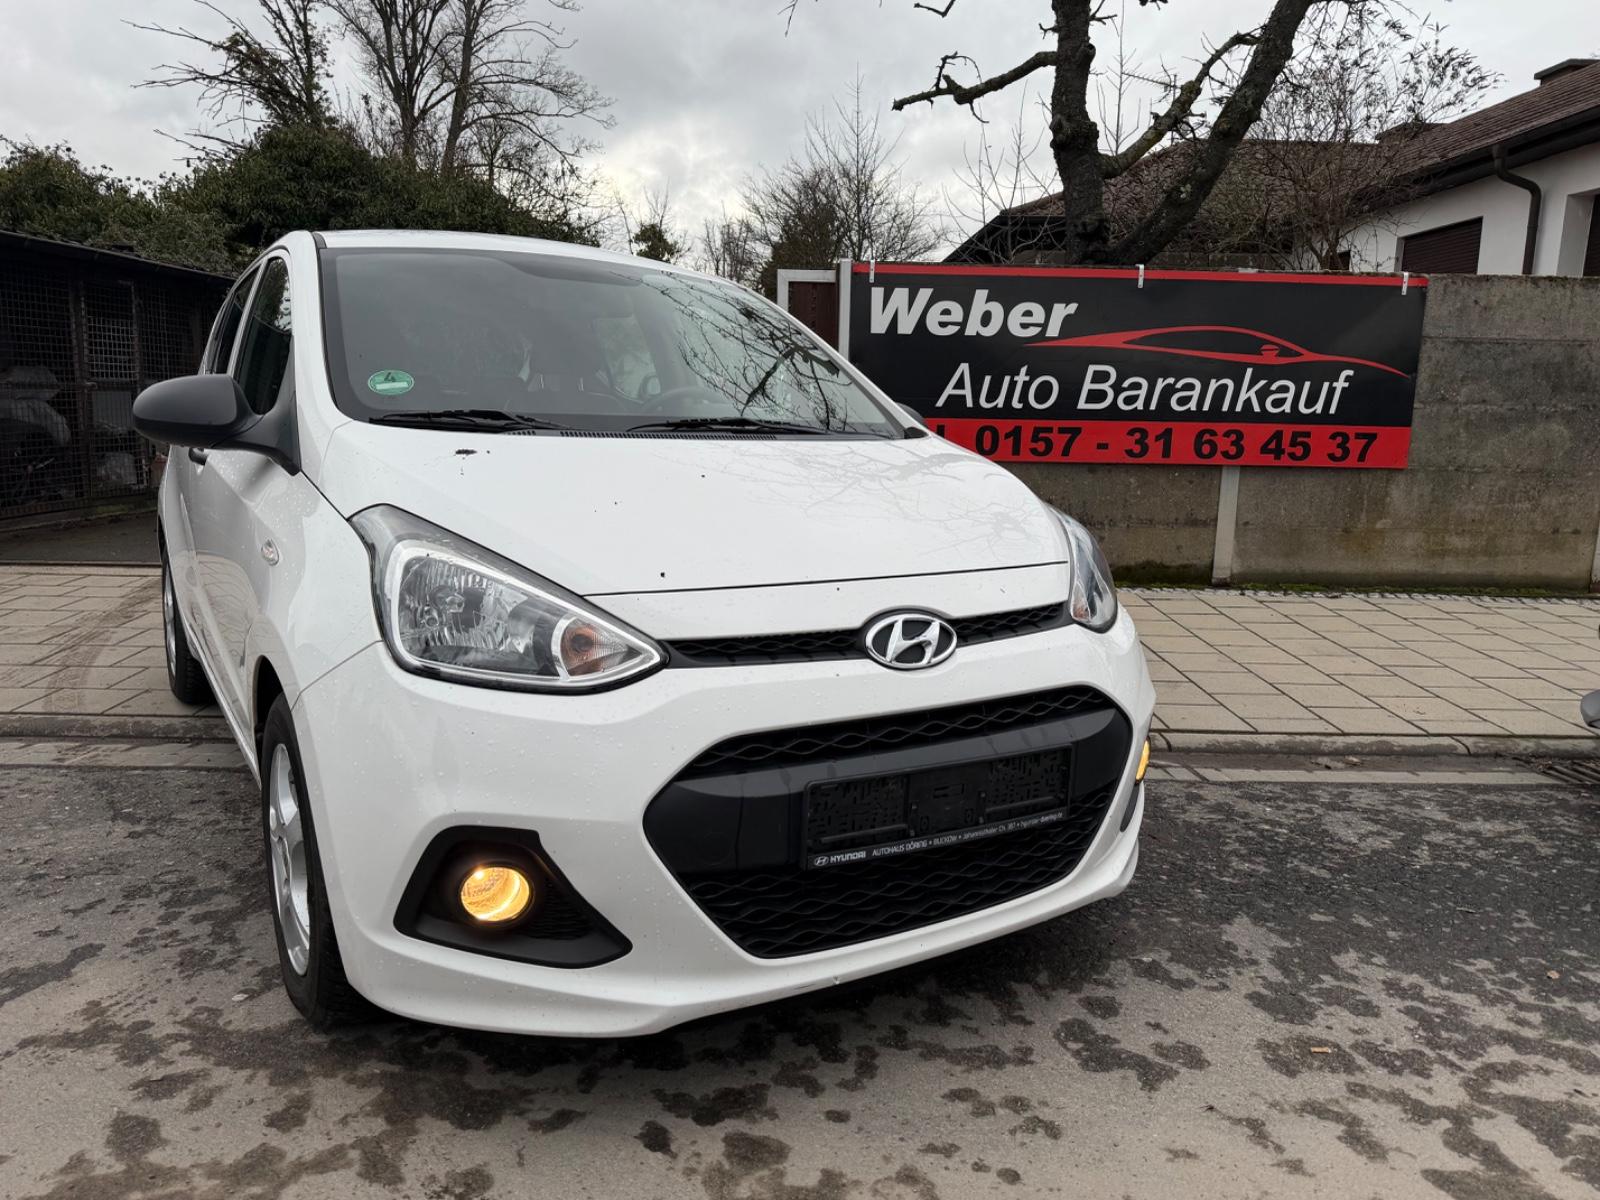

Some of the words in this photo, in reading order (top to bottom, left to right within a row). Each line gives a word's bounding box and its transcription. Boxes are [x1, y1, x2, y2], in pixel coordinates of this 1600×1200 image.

[870, 286, 1079, 338] Weber
[935, 362, 1060, 410] Auto
[1076, 364, 1355, 415] Barankauf
[975, 425, 1082, 457] 0157
[1096, 442, 1109, 450] -
[1124, 427, 1173, 459] 31
[1193, 428, 1245, 461] 63
[1260, 429, 1312, 462] 45
[1327, 431, 1378, 463] 37
[830, 851, 866, 863] HYUNDAI
[872, 844, 904, 857] AUTOHAUS
